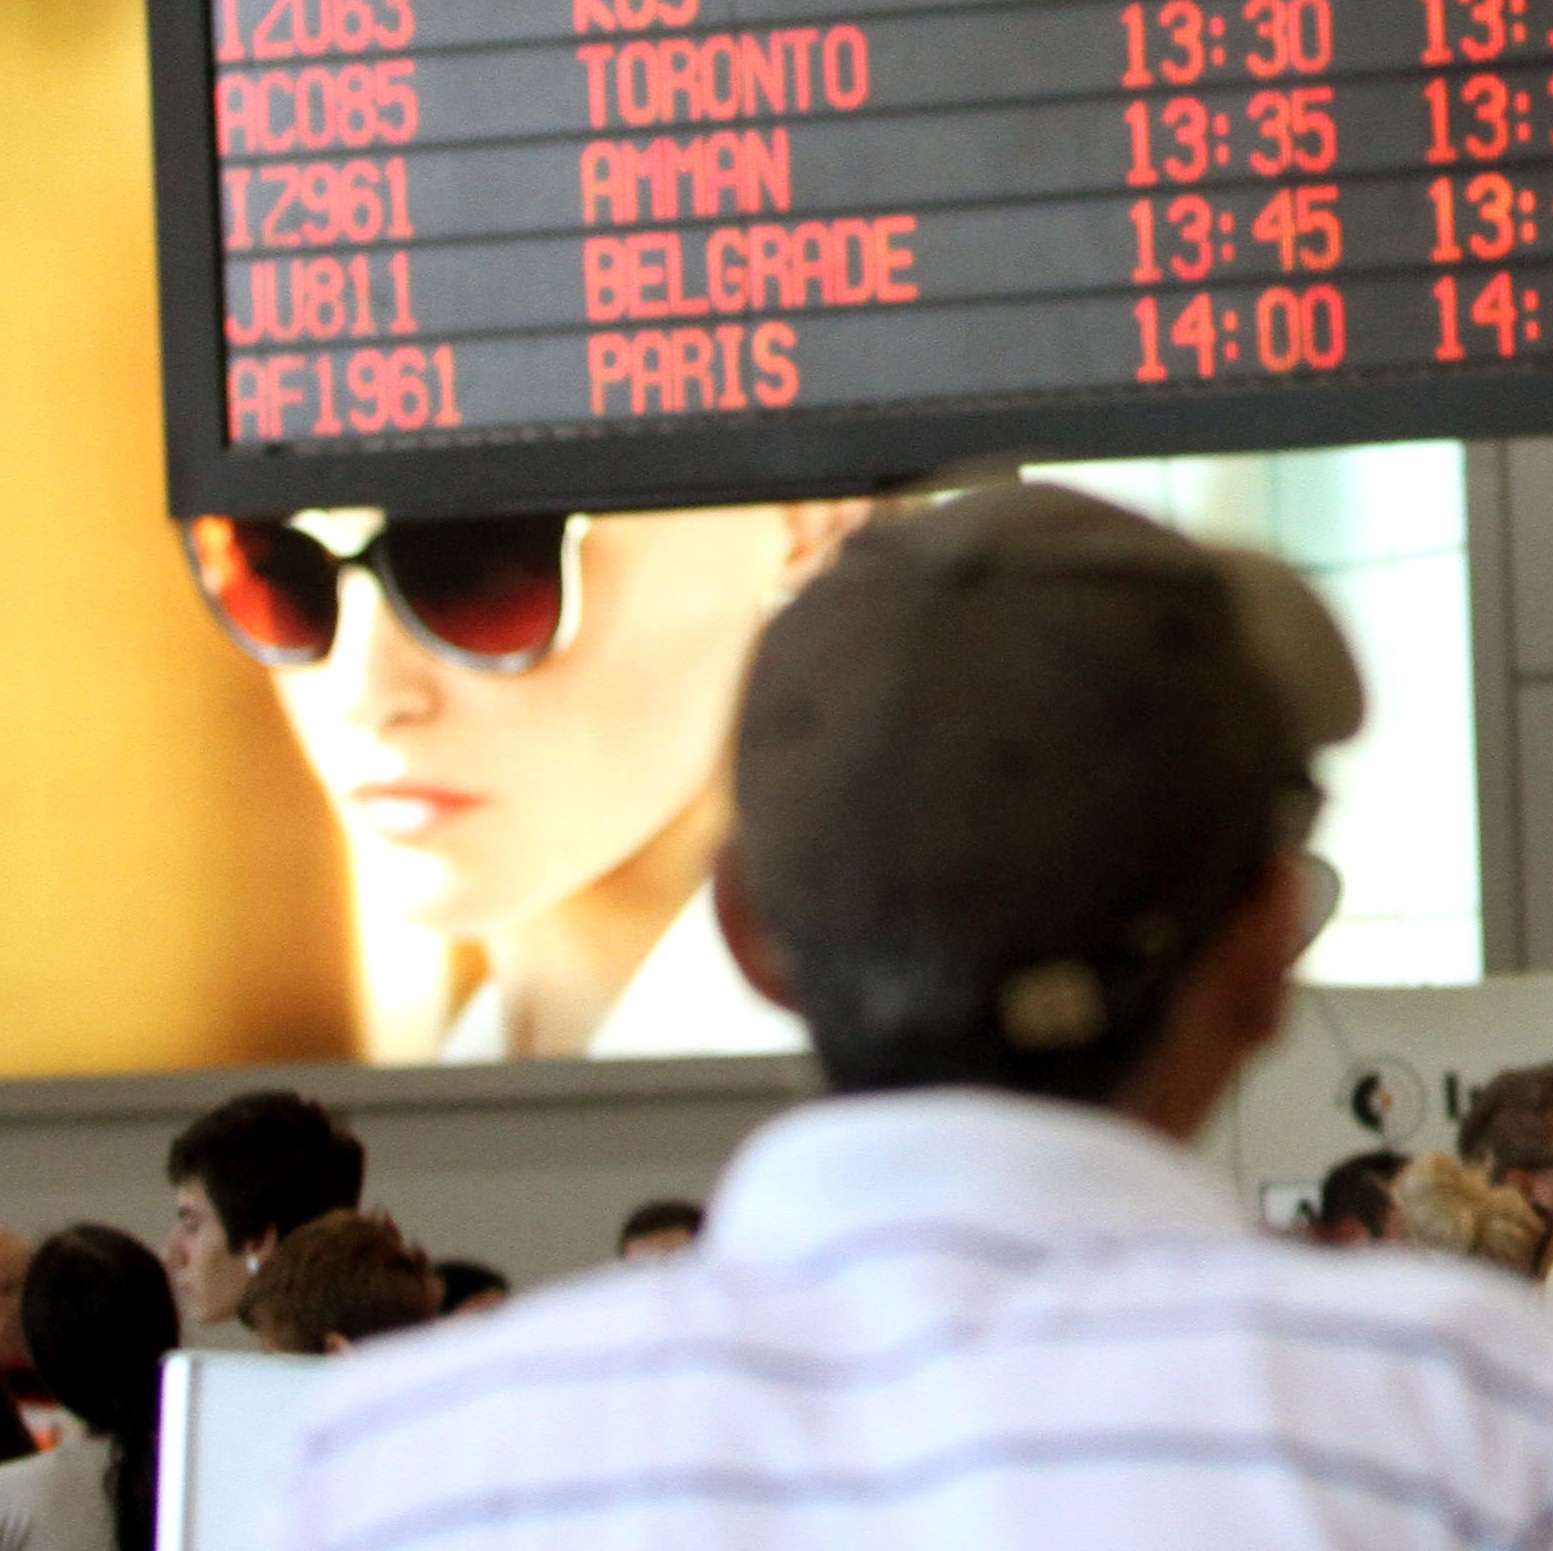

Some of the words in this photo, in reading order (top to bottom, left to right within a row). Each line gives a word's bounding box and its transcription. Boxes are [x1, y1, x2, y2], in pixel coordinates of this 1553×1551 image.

[214, 59, 419, 155] AC085
[578, 25, 869, 128] TORONTO
[227, 157, 413, 247] IZ961
[582, 128, 792, 223] AMMAN
[1125, 86, 1339, 187] 13:35
[225, 252, 417, 345] JU811
[585, 215, 919, 322] BELGRADE
[1130, 184, 1343, 284] 13:45
[228, 347, 459, 439] AF1961
[589, 322, 799, 414] PARIS
[1135, 283, 1347, 382] 14:00
